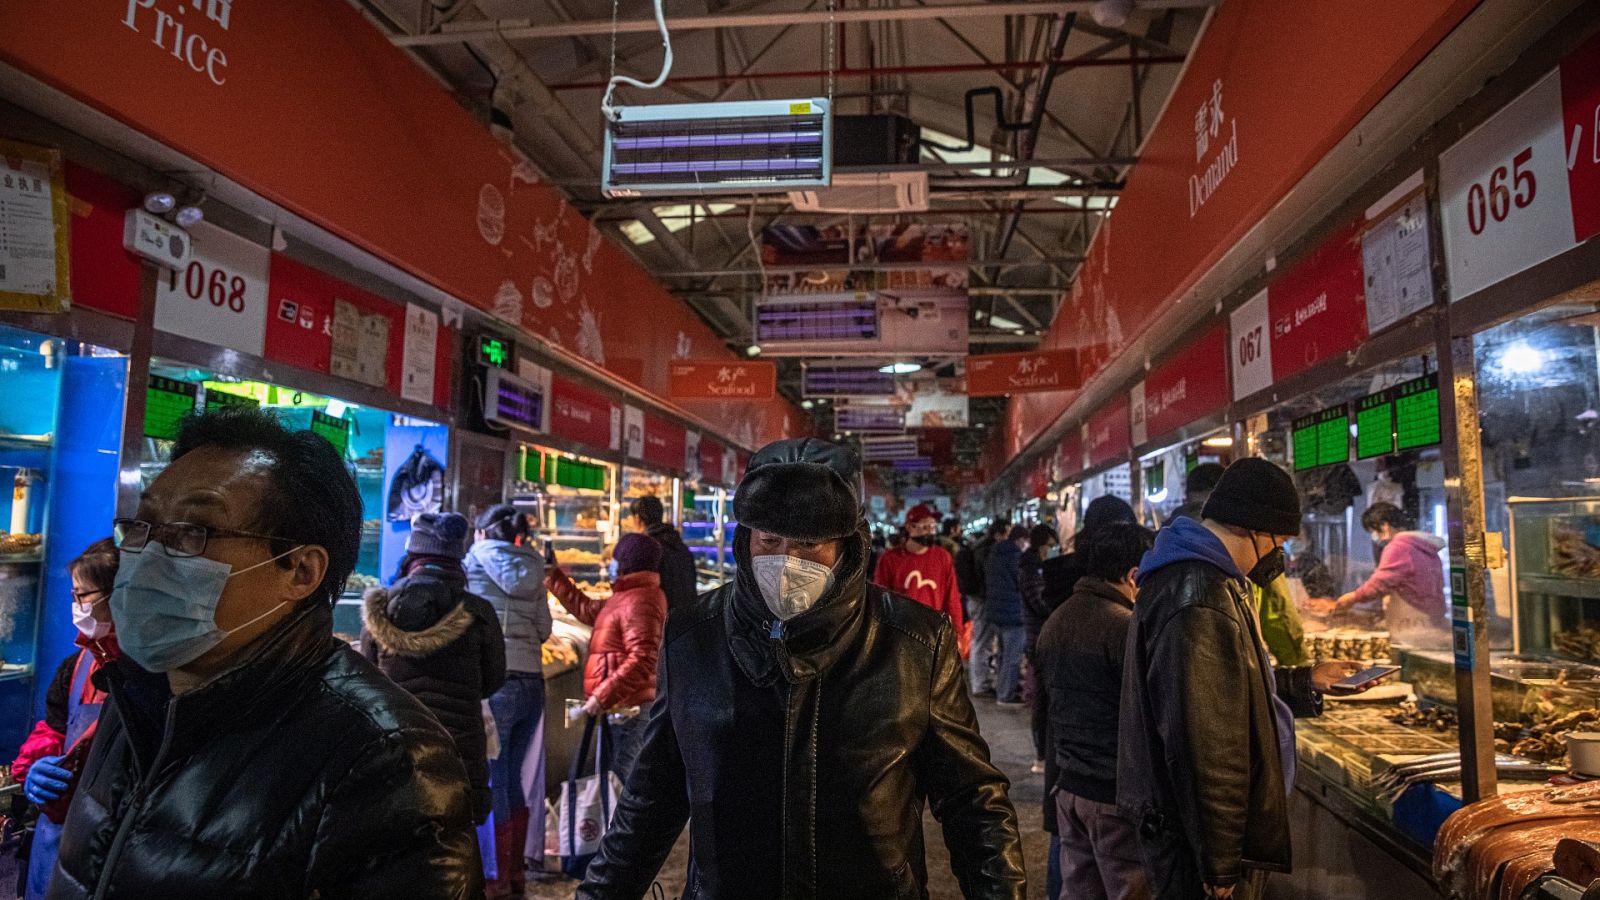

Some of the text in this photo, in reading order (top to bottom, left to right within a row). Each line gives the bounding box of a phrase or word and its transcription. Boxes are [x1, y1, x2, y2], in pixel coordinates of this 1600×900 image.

[120, 0, 228, 86] Price
[1194, 78, 1225, 163] 需求
[1188, 117, 1238, 219] Demand
[1467, 146, 1536, 235] 065
[185, 261, 246, 314] 068
[1008, 372, 1059, 387] Seafood
[1239, 326, 1263, 367] 067
[707, 382, 756, 396] Seafood
